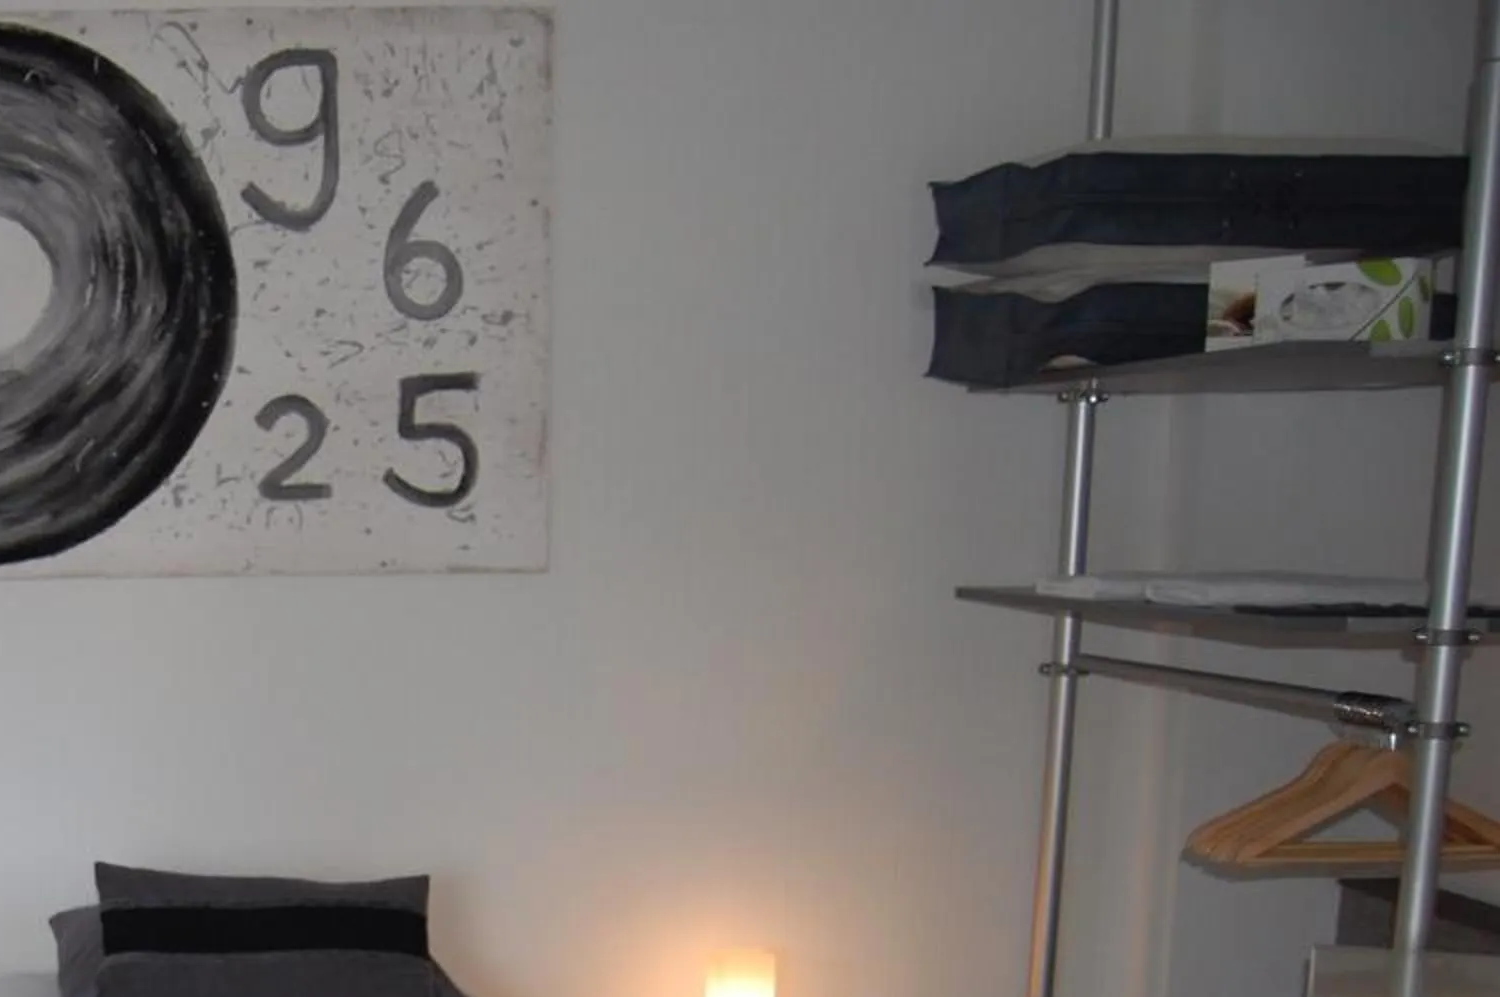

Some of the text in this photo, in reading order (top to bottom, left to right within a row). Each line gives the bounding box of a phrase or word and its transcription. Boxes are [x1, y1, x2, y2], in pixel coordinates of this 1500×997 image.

[240, 47, 339, 232] 9
[383, 180, 464, 322] 6
[255, 372, 481, 508] 2 5
